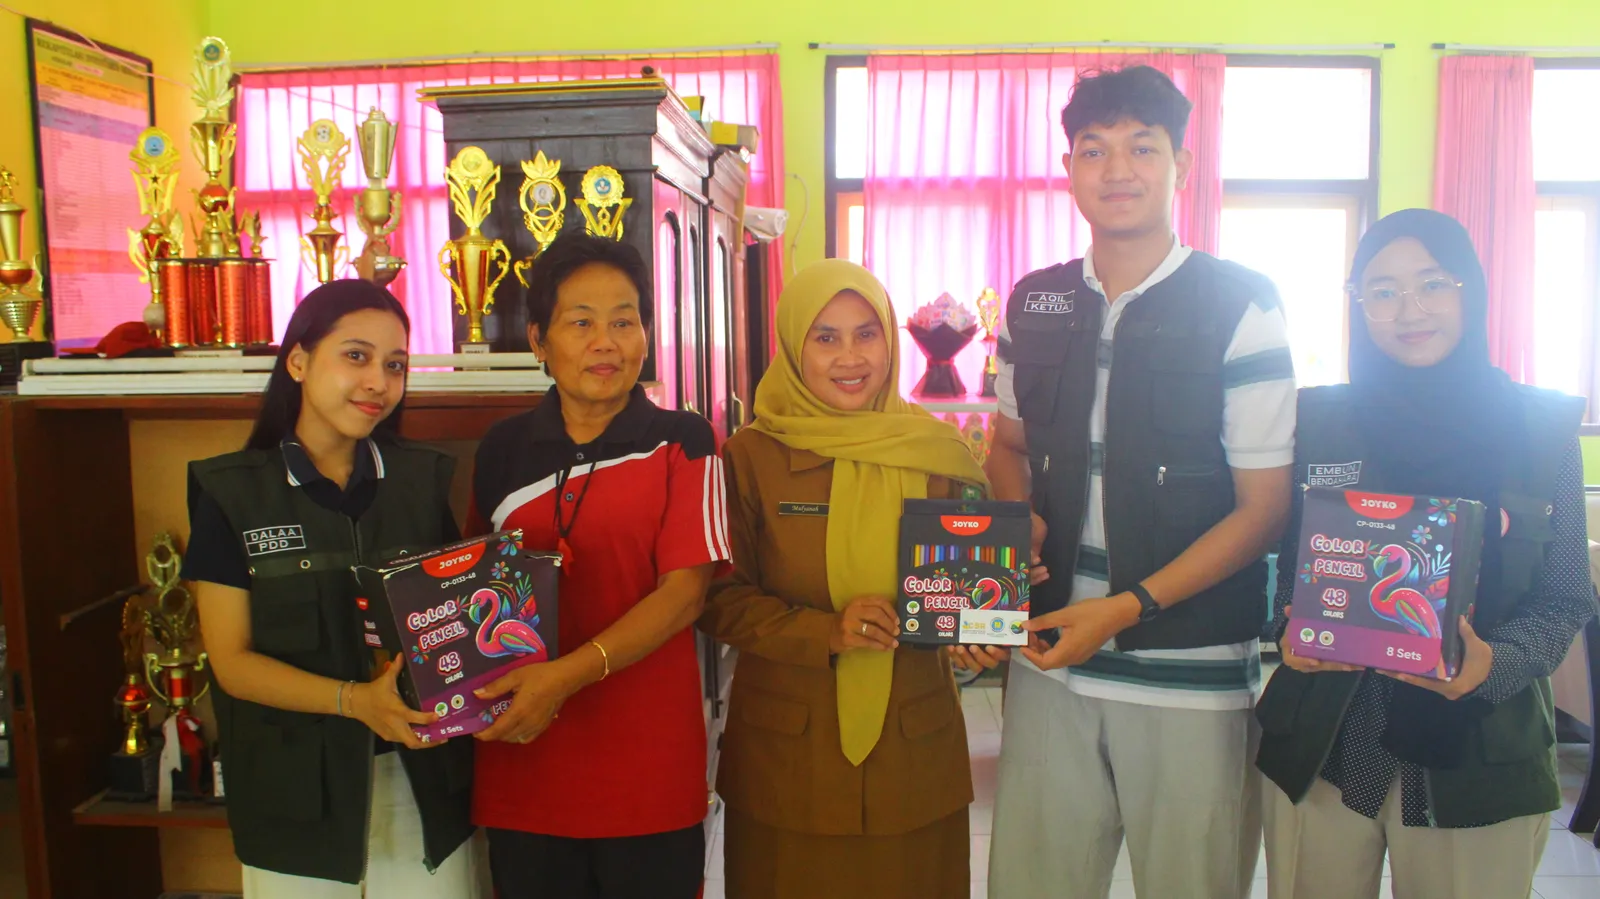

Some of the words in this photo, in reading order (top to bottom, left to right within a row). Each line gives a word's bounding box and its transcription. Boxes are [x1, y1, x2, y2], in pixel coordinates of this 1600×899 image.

[1031, 303, 1069, 311] KETUA
[1316, 464, 1356, 475] EMBUN
[1361, 499, 1397, 509] JOYKO
[952, 520, 979, 528] JOYKO
[1356, 520, 1396, 530] CP-0133-48
[250, 528, 296, 541] DALAA
[259, 539, 289, 552] PDD
[439, 553, 472, 569] JOYKO
[1315, 559, 1365, 578] PENCIL
[440, 572, 476, 588] CP-0133-48
[924, 596, 970, 610] PENCIL
[1322, 588, 1347, 606] 48
[936, 616, 954, 629] 48
[419, 621, 466, 649] PENCIL
[1386, 646, 1394, 657] 8
[1397, 648, 1422, 661] Sets
[438, 652, 461, 672] 48
[446, 725, 464, 734] Sets
